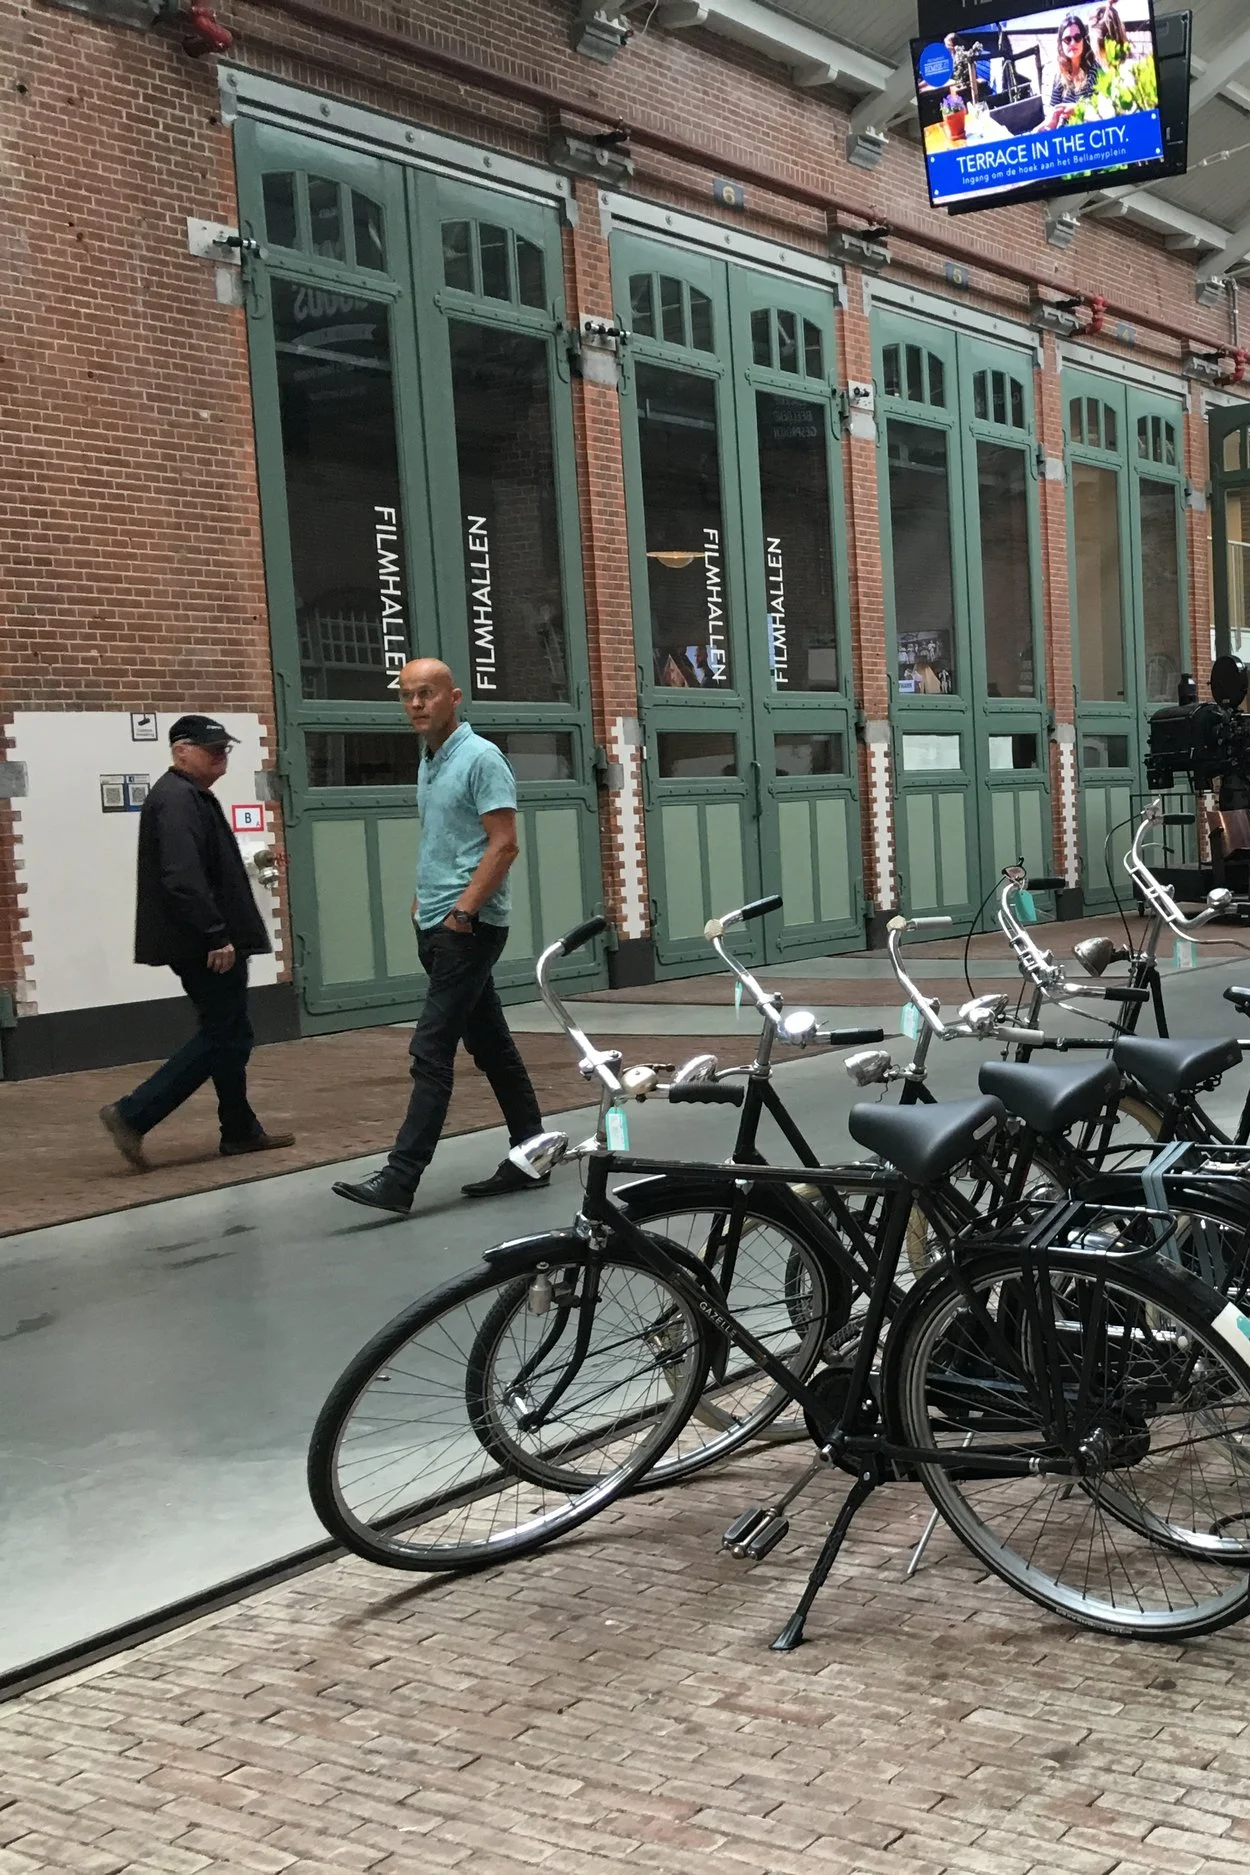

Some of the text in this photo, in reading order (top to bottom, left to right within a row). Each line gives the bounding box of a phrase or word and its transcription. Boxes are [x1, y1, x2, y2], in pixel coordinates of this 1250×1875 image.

[956, 125, 1129, 174] TERRACE IN THE CITY.
[962, 148, 1127, 186] Ingang om de hoek aan het Bellamyplein
[723, 186, 735, 205] 6
[374, 506, 408, 690] FILMHALLEN
[467, 515, 497, 690] FILMHALLEN
[703, 528, 727, 681] FILMHALLEN
[767, 537, 789, 683] FILMHALLEN
[245, 812, 252, 824] B
[699, 1301, 738, 1338] GAZELLE
